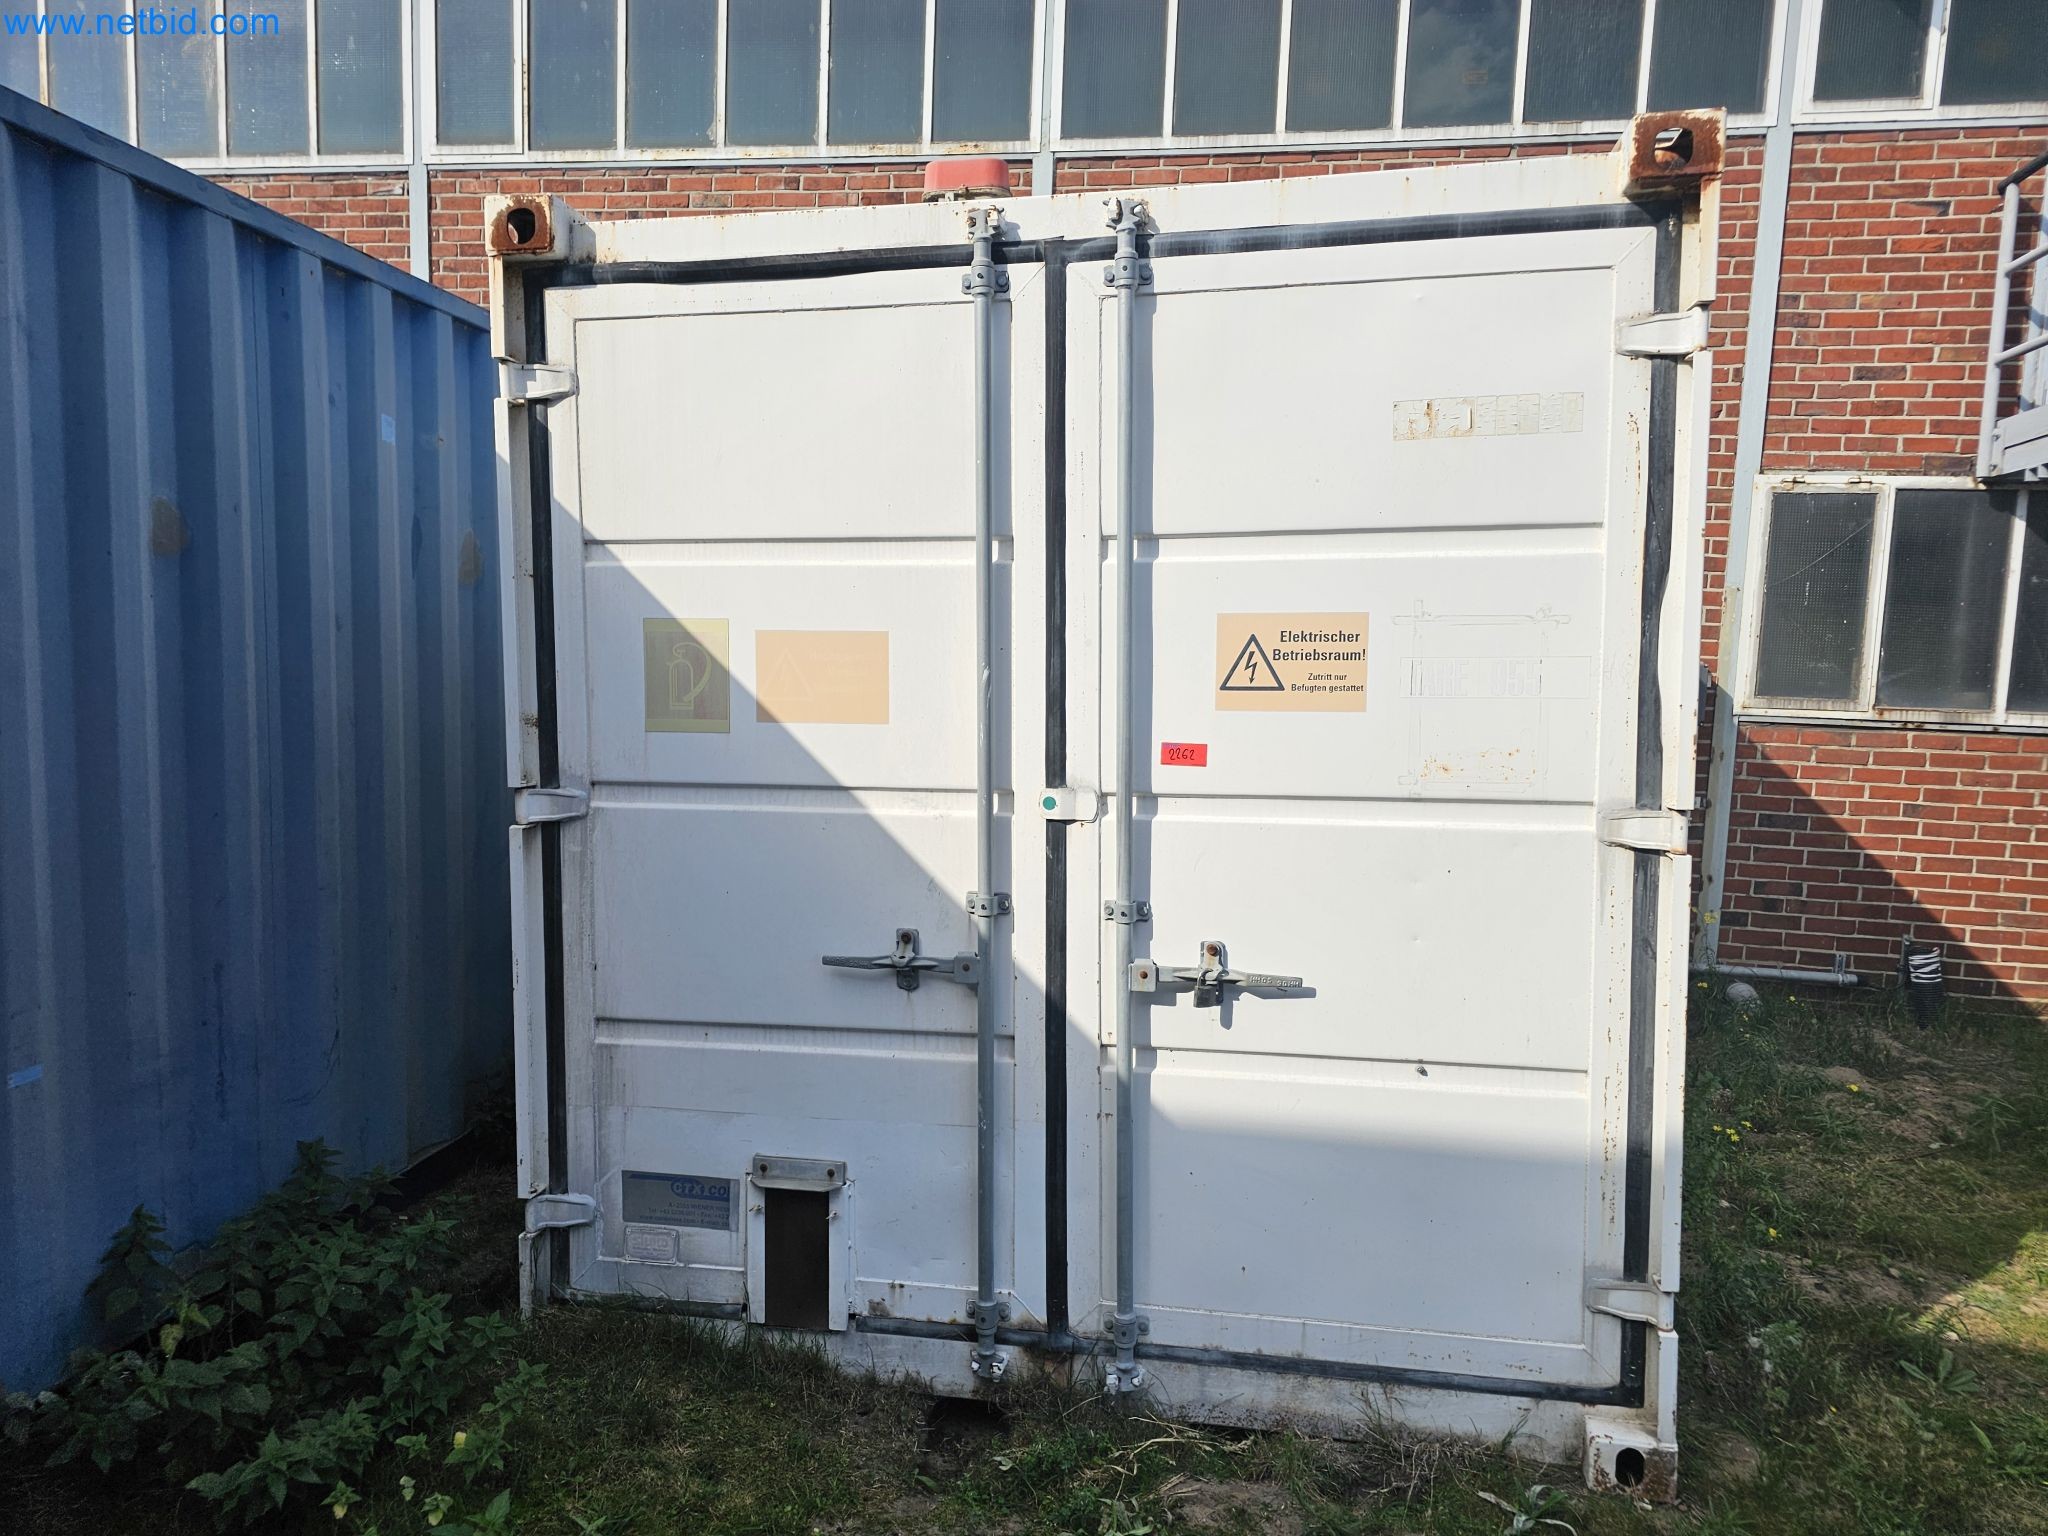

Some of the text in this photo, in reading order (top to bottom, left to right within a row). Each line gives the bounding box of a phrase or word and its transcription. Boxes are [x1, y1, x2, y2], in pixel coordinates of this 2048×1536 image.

[1280, 630, 1361, 643] Elektrischer
[1272, 648, 1366, 661] Betriebsraum!
[1307, 673, 1332, 681] Zutritt
[1291, 684, 1364, 693] Befugten gestattet
[1168, 747, 1195, 761] 2262
[708, 1184, 730, 1197] CO
